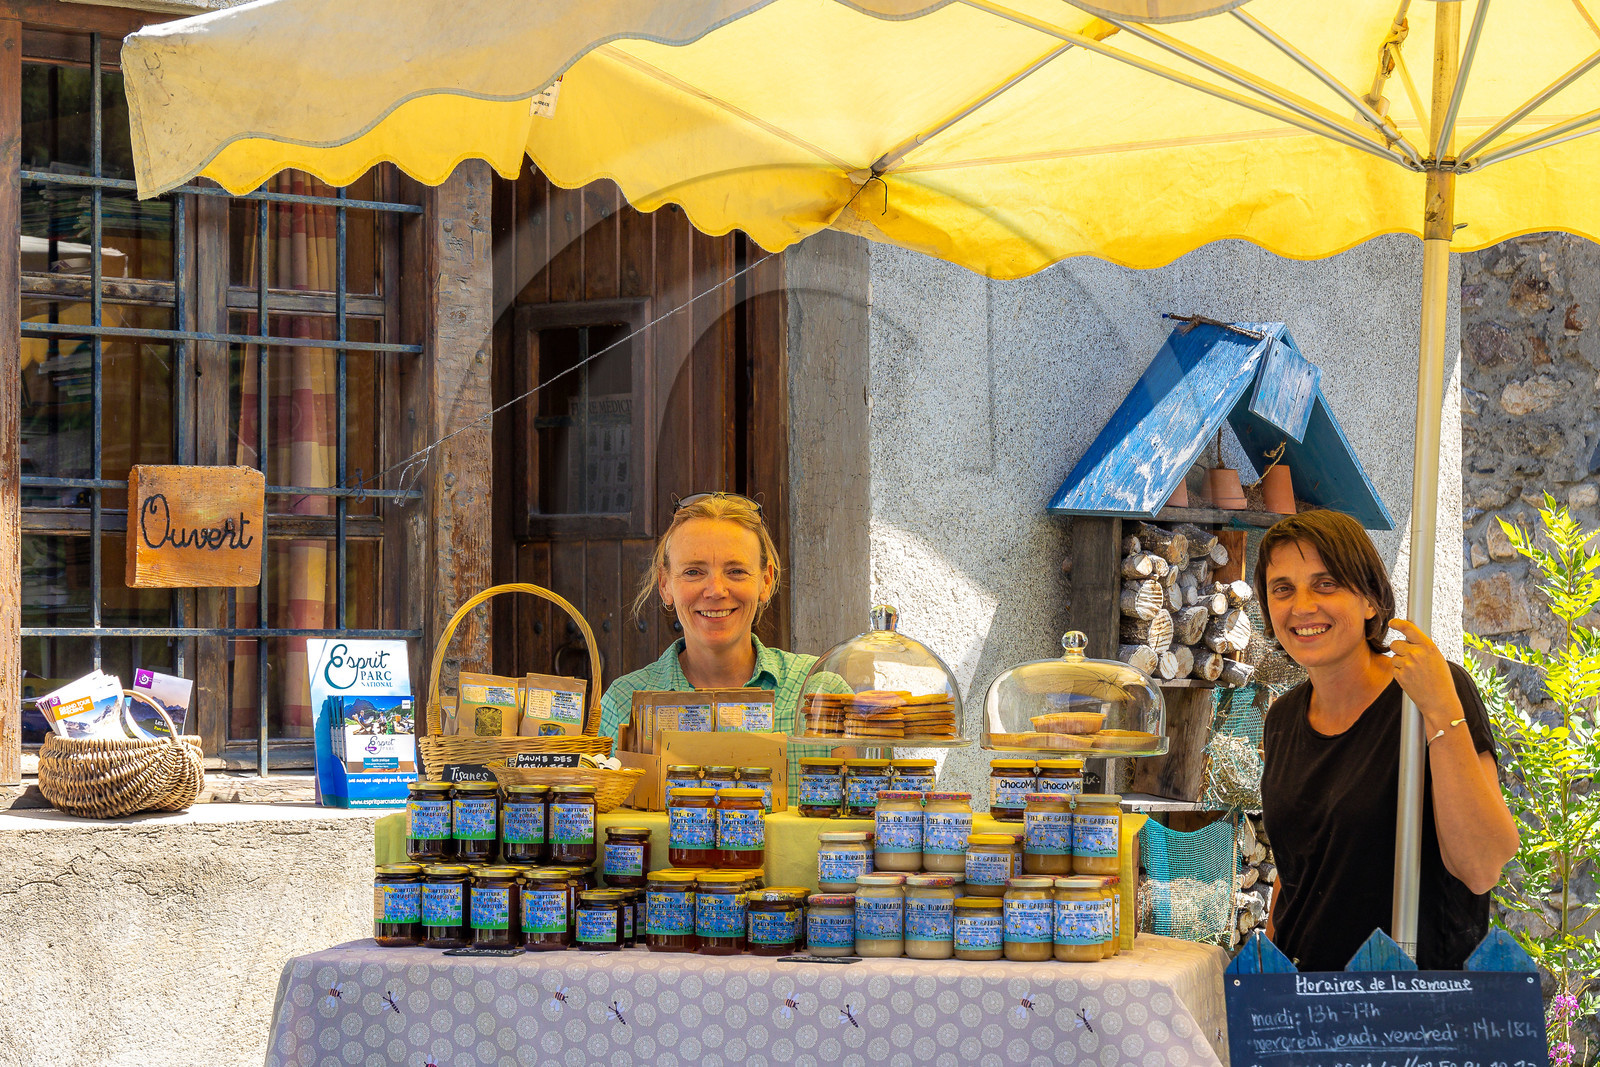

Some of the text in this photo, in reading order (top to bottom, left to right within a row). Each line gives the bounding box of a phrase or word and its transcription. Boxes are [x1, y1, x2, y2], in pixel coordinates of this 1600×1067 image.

[140, 493, 253, 550] Ouvert
[324, 643, 390, 690] Esprit
[360, 670, 392, 681] PARC
[518, 754, 549, 763] BAUME
[553, 755, 573, 763] DES
[450, 766, 489, 782] Tisanes
[1295, 974, 1473, 993] Horaires de la semaine
